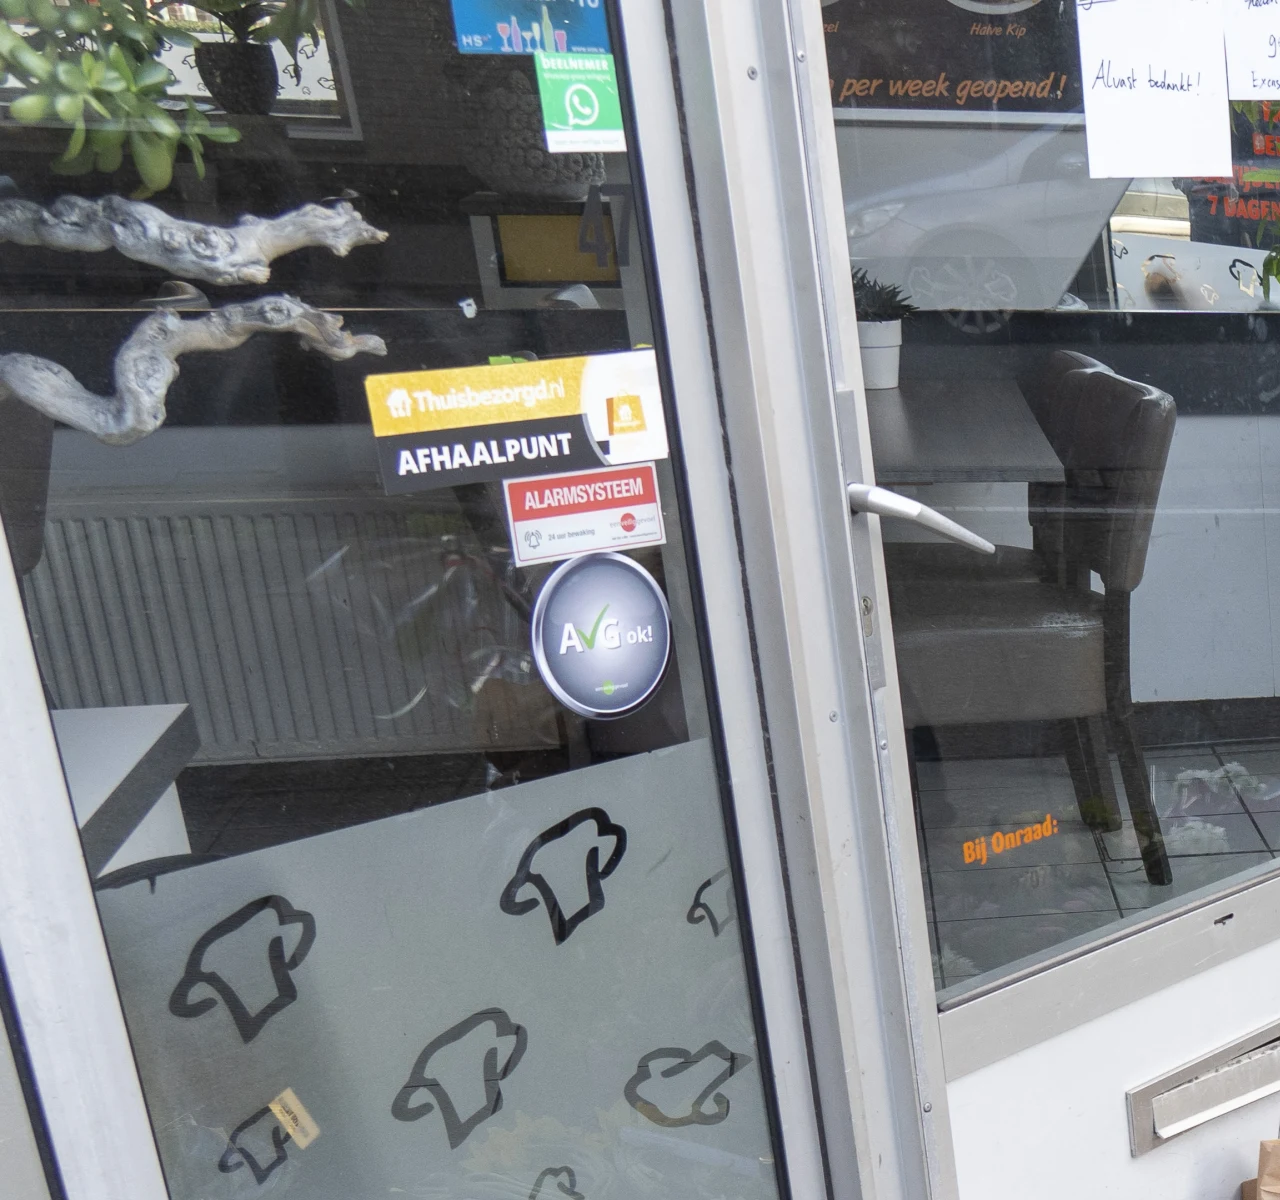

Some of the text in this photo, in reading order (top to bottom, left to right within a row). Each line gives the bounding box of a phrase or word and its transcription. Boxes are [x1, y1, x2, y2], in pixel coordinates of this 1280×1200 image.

[970, 22, 1027, 38] Halve Kip
[838, 77, 883, 102] per
[889, 72, 951, 97] week
[579, 183, 634, 269] 47
[411, 377, 566, 414] Thuisbezorgd.nl
[398, 432, 572, 476] AFHAALPUNT
[524, 477, 644, 511] ALARMSYSTEEM
[626, 625, 653, 645] ok!
[963, 813, 1058, 865] Bij Onraad:
